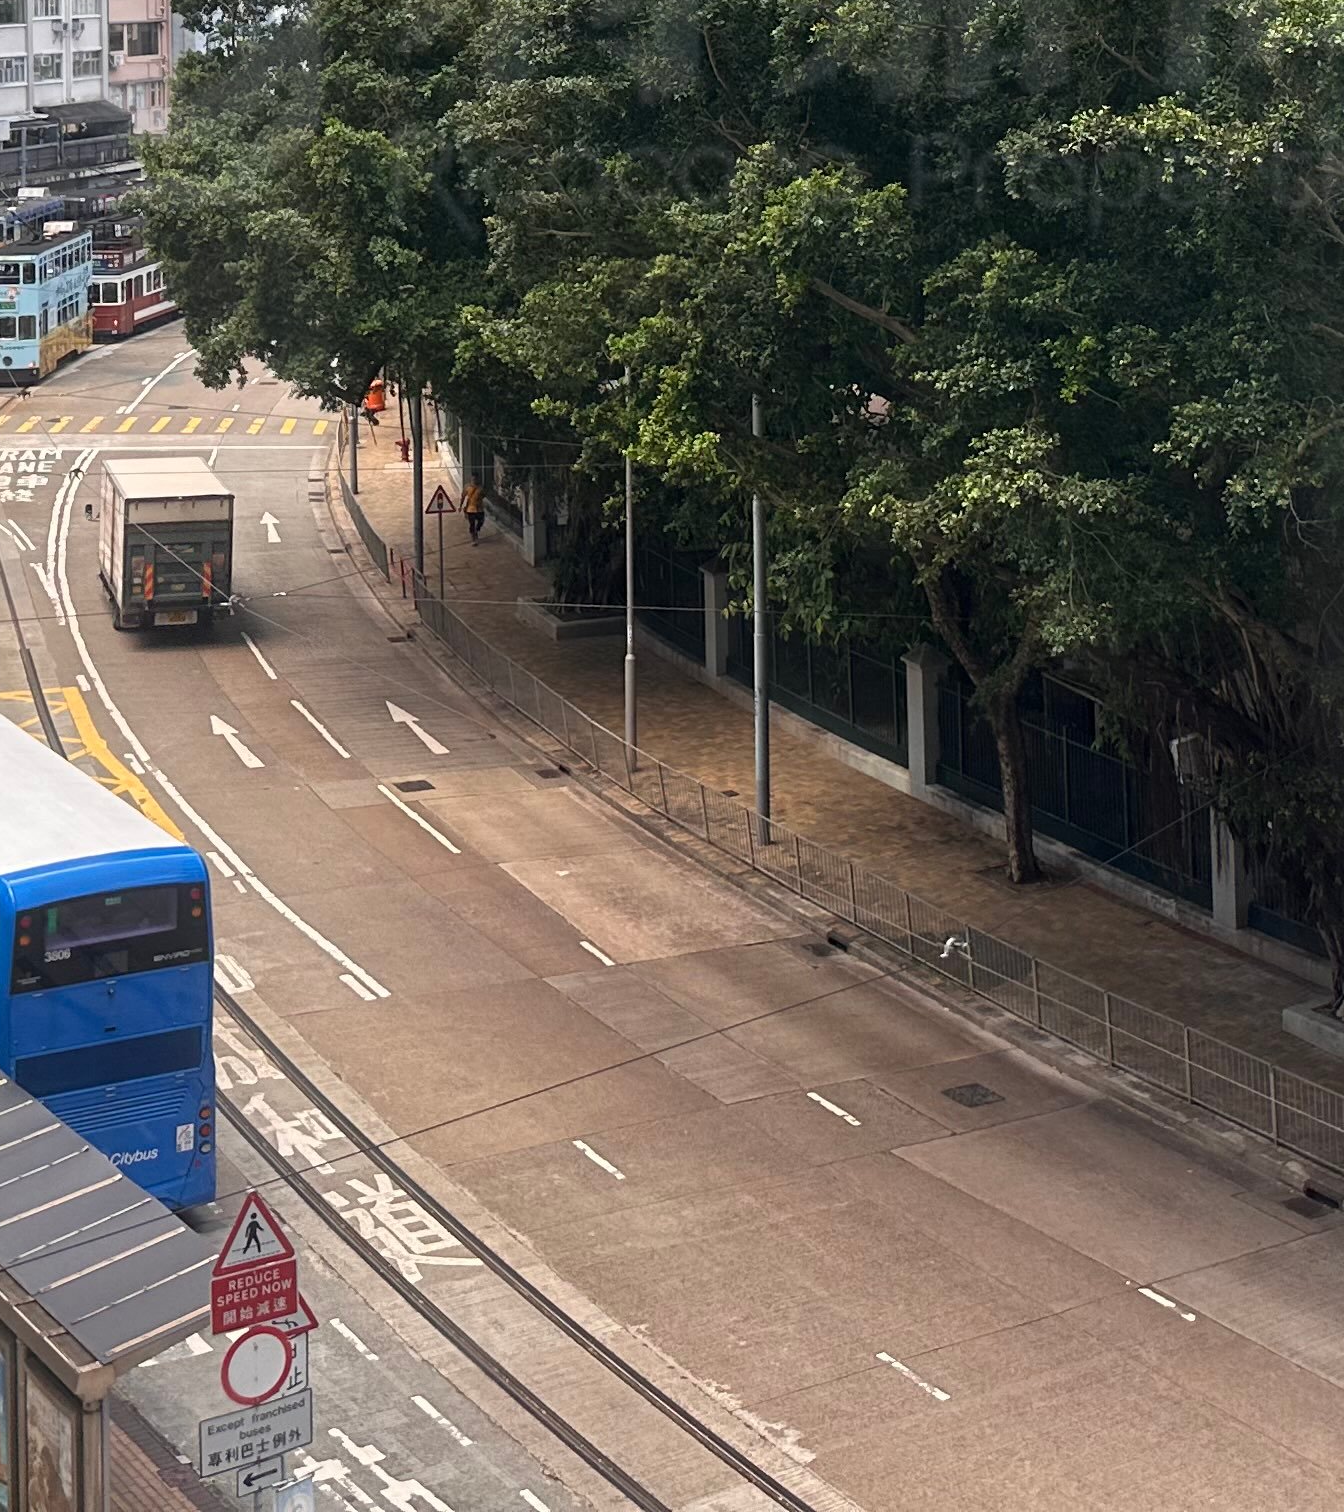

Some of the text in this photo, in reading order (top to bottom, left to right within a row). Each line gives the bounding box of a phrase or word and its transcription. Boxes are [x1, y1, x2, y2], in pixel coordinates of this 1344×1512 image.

[111, 1147, 159, 1167] Citybus
[216, 1278, 293, 1307] SPEED NOW
[228, 1269, 281, 1292] REDUCE
[222, 1296, 289, 1326] 開始減速
[207, 1398, 306, 1436] Except franchised
[239, 1423, 272, 1441] buses
[207, 1431, 303, 1467] 專利巴士例外
